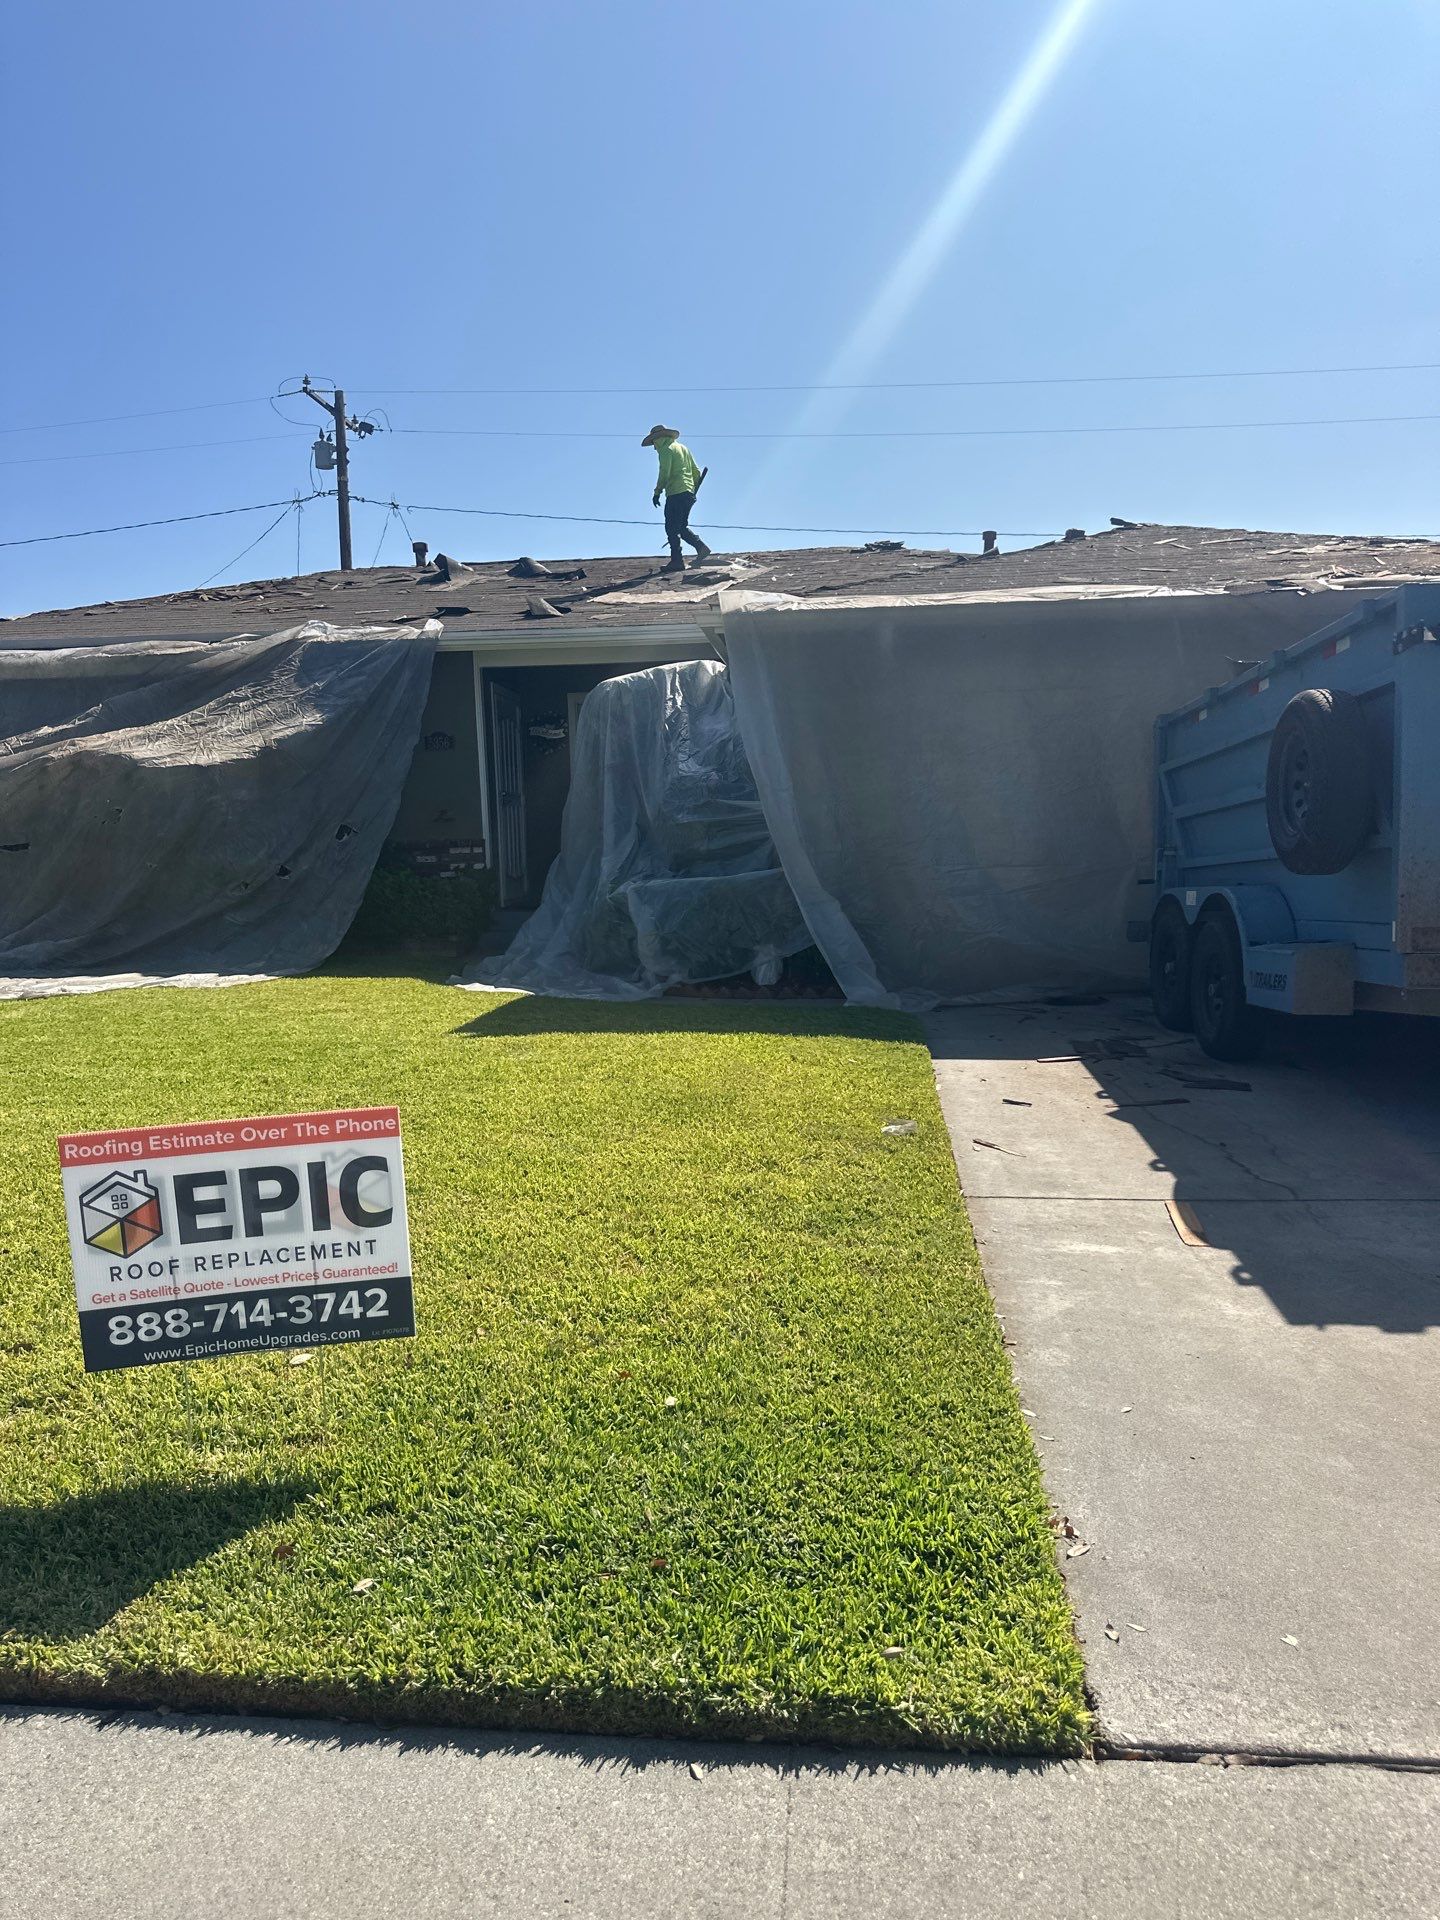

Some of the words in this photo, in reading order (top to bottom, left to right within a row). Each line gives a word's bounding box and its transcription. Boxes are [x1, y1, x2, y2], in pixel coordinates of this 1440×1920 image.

[64, 1139, 143, 1159] Roofing
[149, 1130, 235, 1151] Estimate
[240, 1127, 288, 1142] Over
[293, 1122, 330, 1137] The
[335, 1118, 396, 1134] Phone
[173, 1155, 394, 1245] EPIC
[109, 1259, 180, 1282] ROOF
[194, 1239, 377, 1272] REPLACEMENT
[92, 1292, 116, 1305] Get
[118, 1292, 127, 1302] a
[129, 1285, 181, 1300] Satellite
[183, 1280, 224, 1294] Quote
[234, 1273, 280, 1288] Lowest
[282, 1271, 320, 1283] Prices
[322, 1262, 399, 1279] Guaranteed!
[108, 1287, 390, 1346] 888-714-3742
[144, 1328, 361, 1361] www.EpicHomeUpgrades.com
